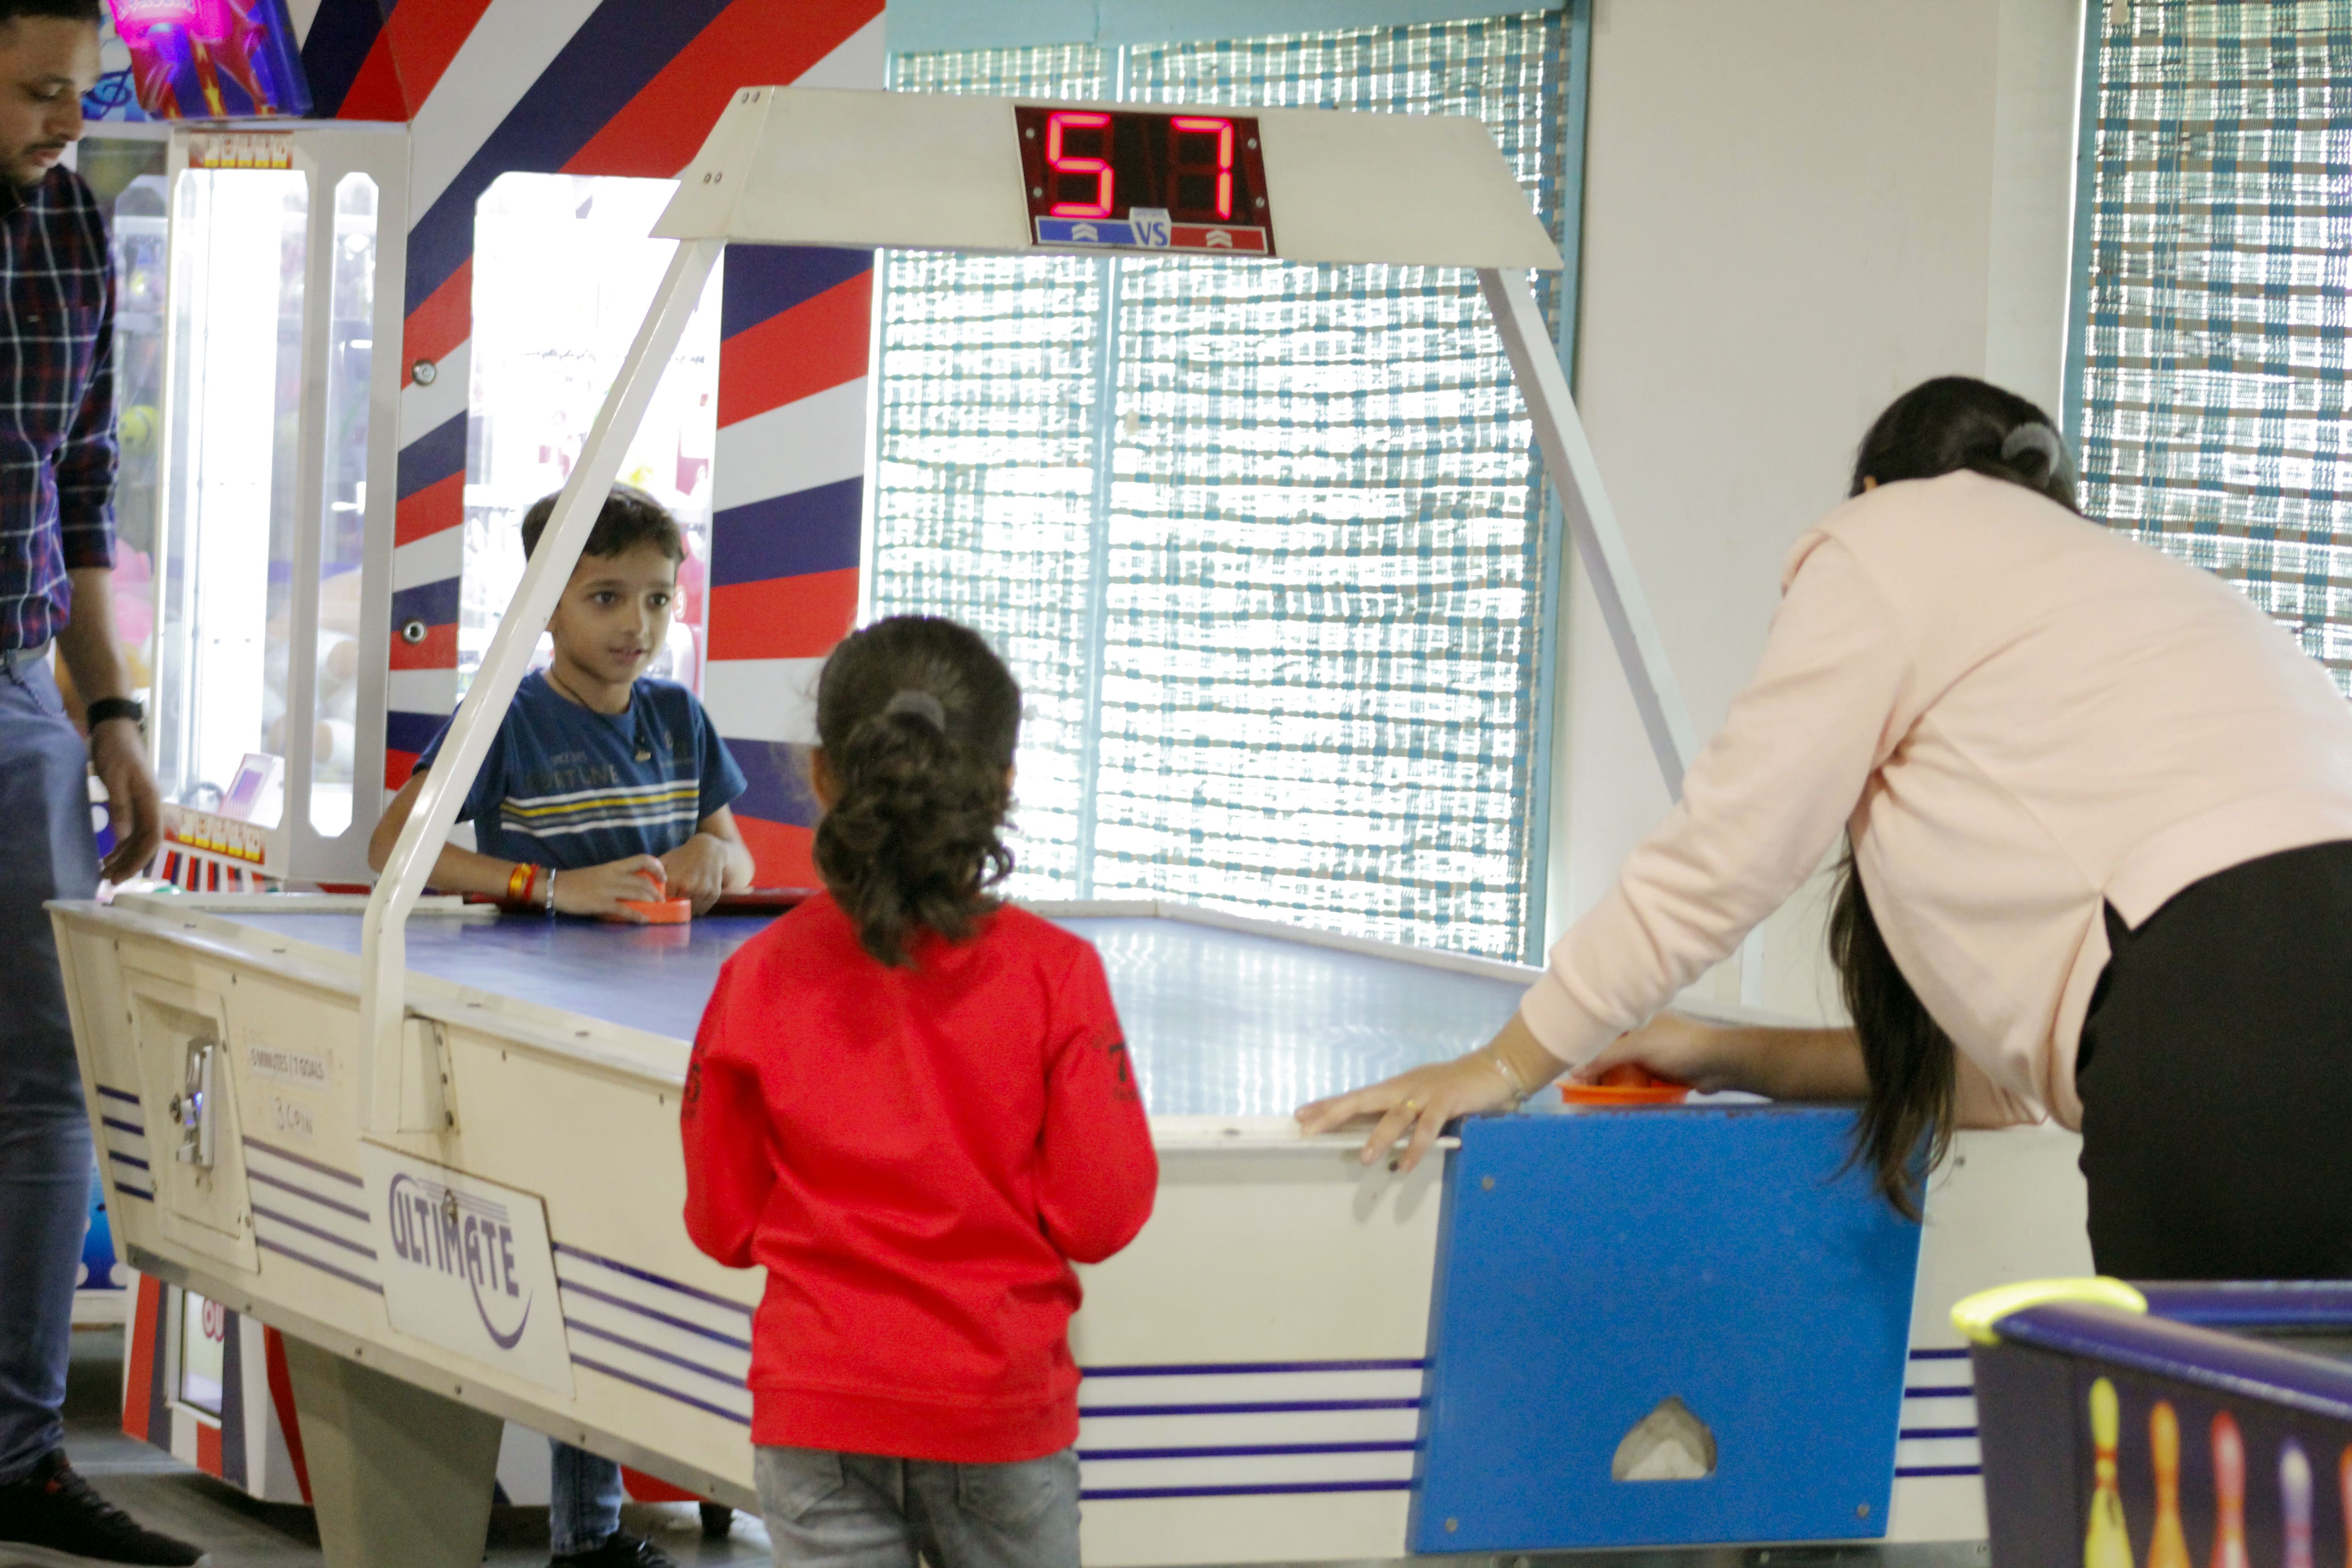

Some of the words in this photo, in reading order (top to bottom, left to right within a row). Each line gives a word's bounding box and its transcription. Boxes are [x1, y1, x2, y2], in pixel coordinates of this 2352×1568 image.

[1047, 112, 1114, 219] 5
[1171, 116, 1234, 220] 7
[1135, 221, 1168, 246] VS
[257, 1049, 289, 1073] MINUTES
[299, 1058, 324, 1081] GOALS
[389, 1172, 532, 1350] ULTIMATE
